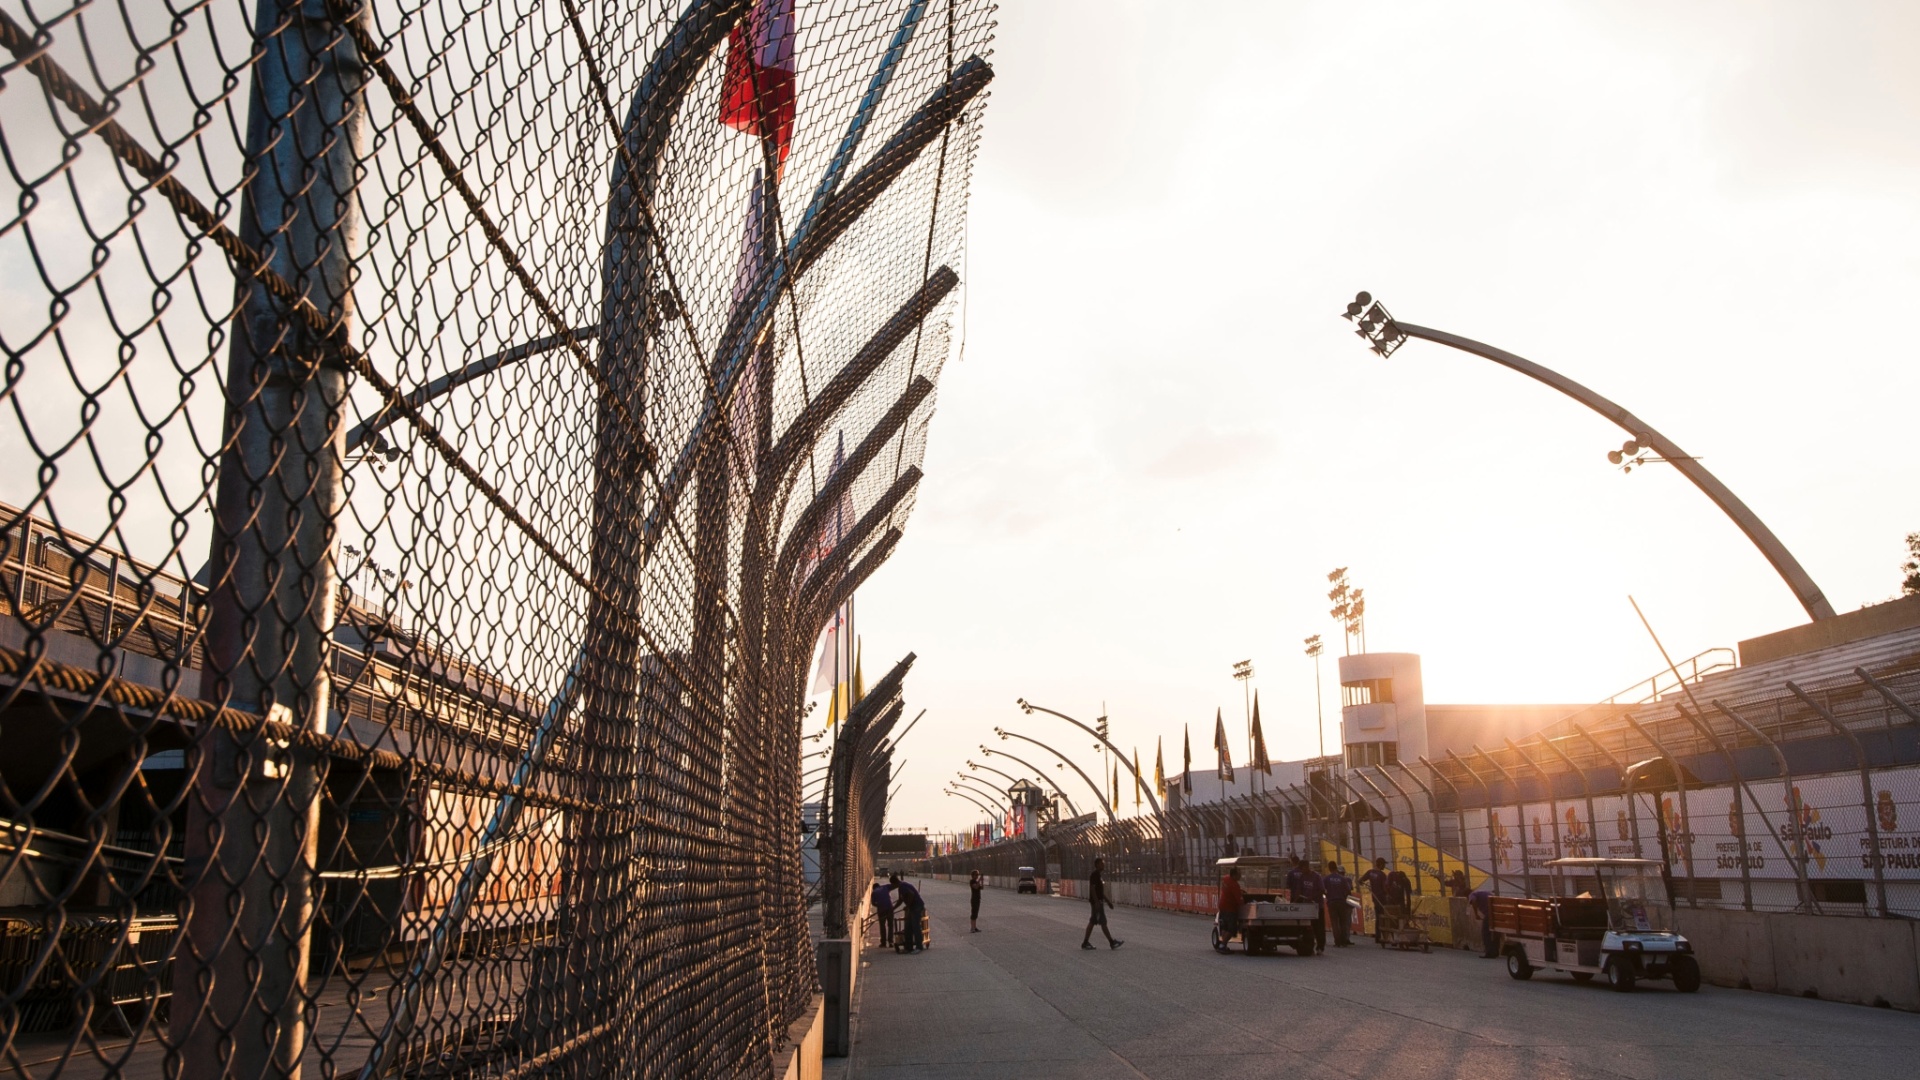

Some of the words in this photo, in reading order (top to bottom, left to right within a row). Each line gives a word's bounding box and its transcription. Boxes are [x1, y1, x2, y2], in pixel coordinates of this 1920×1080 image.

[1780, 822, 1832, 842] SãPaulo
[1716, 842, 1752, 852] PREFEITA
[1753, 841, 1763, 851] DE
[1860, 837, 1910, 849] PREITURA
[1717, 853, 1735, 869] SÃO
[1735, 856, 1764, 869] PULO
[1275, 904, 1289, 912] Club
[1290, 904, 1300, 912] Car
